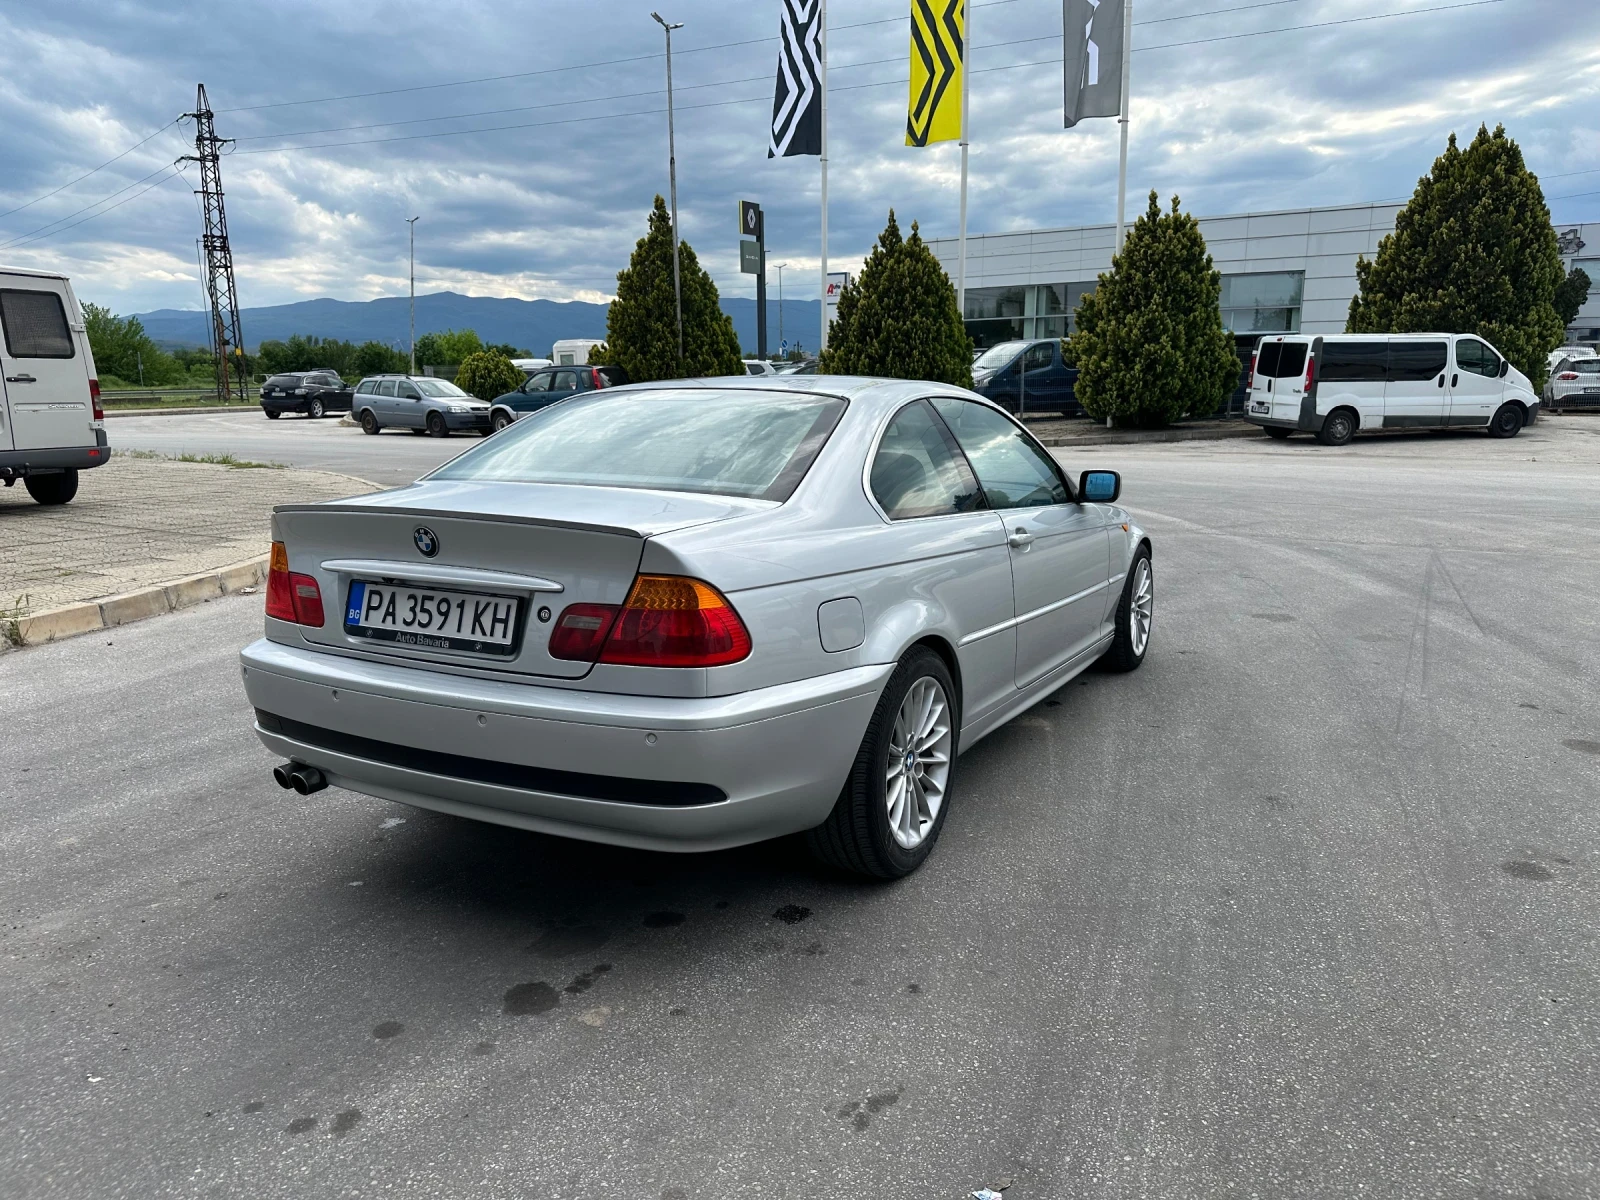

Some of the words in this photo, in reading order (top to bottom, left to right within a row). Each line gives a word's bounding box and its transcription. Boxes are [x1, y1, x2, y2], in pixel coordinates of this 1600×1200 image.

[348, 608, 360, 620] BG
[395, 632, 416, 645] Auto
[416, 635, 450, 648] Bavaria
